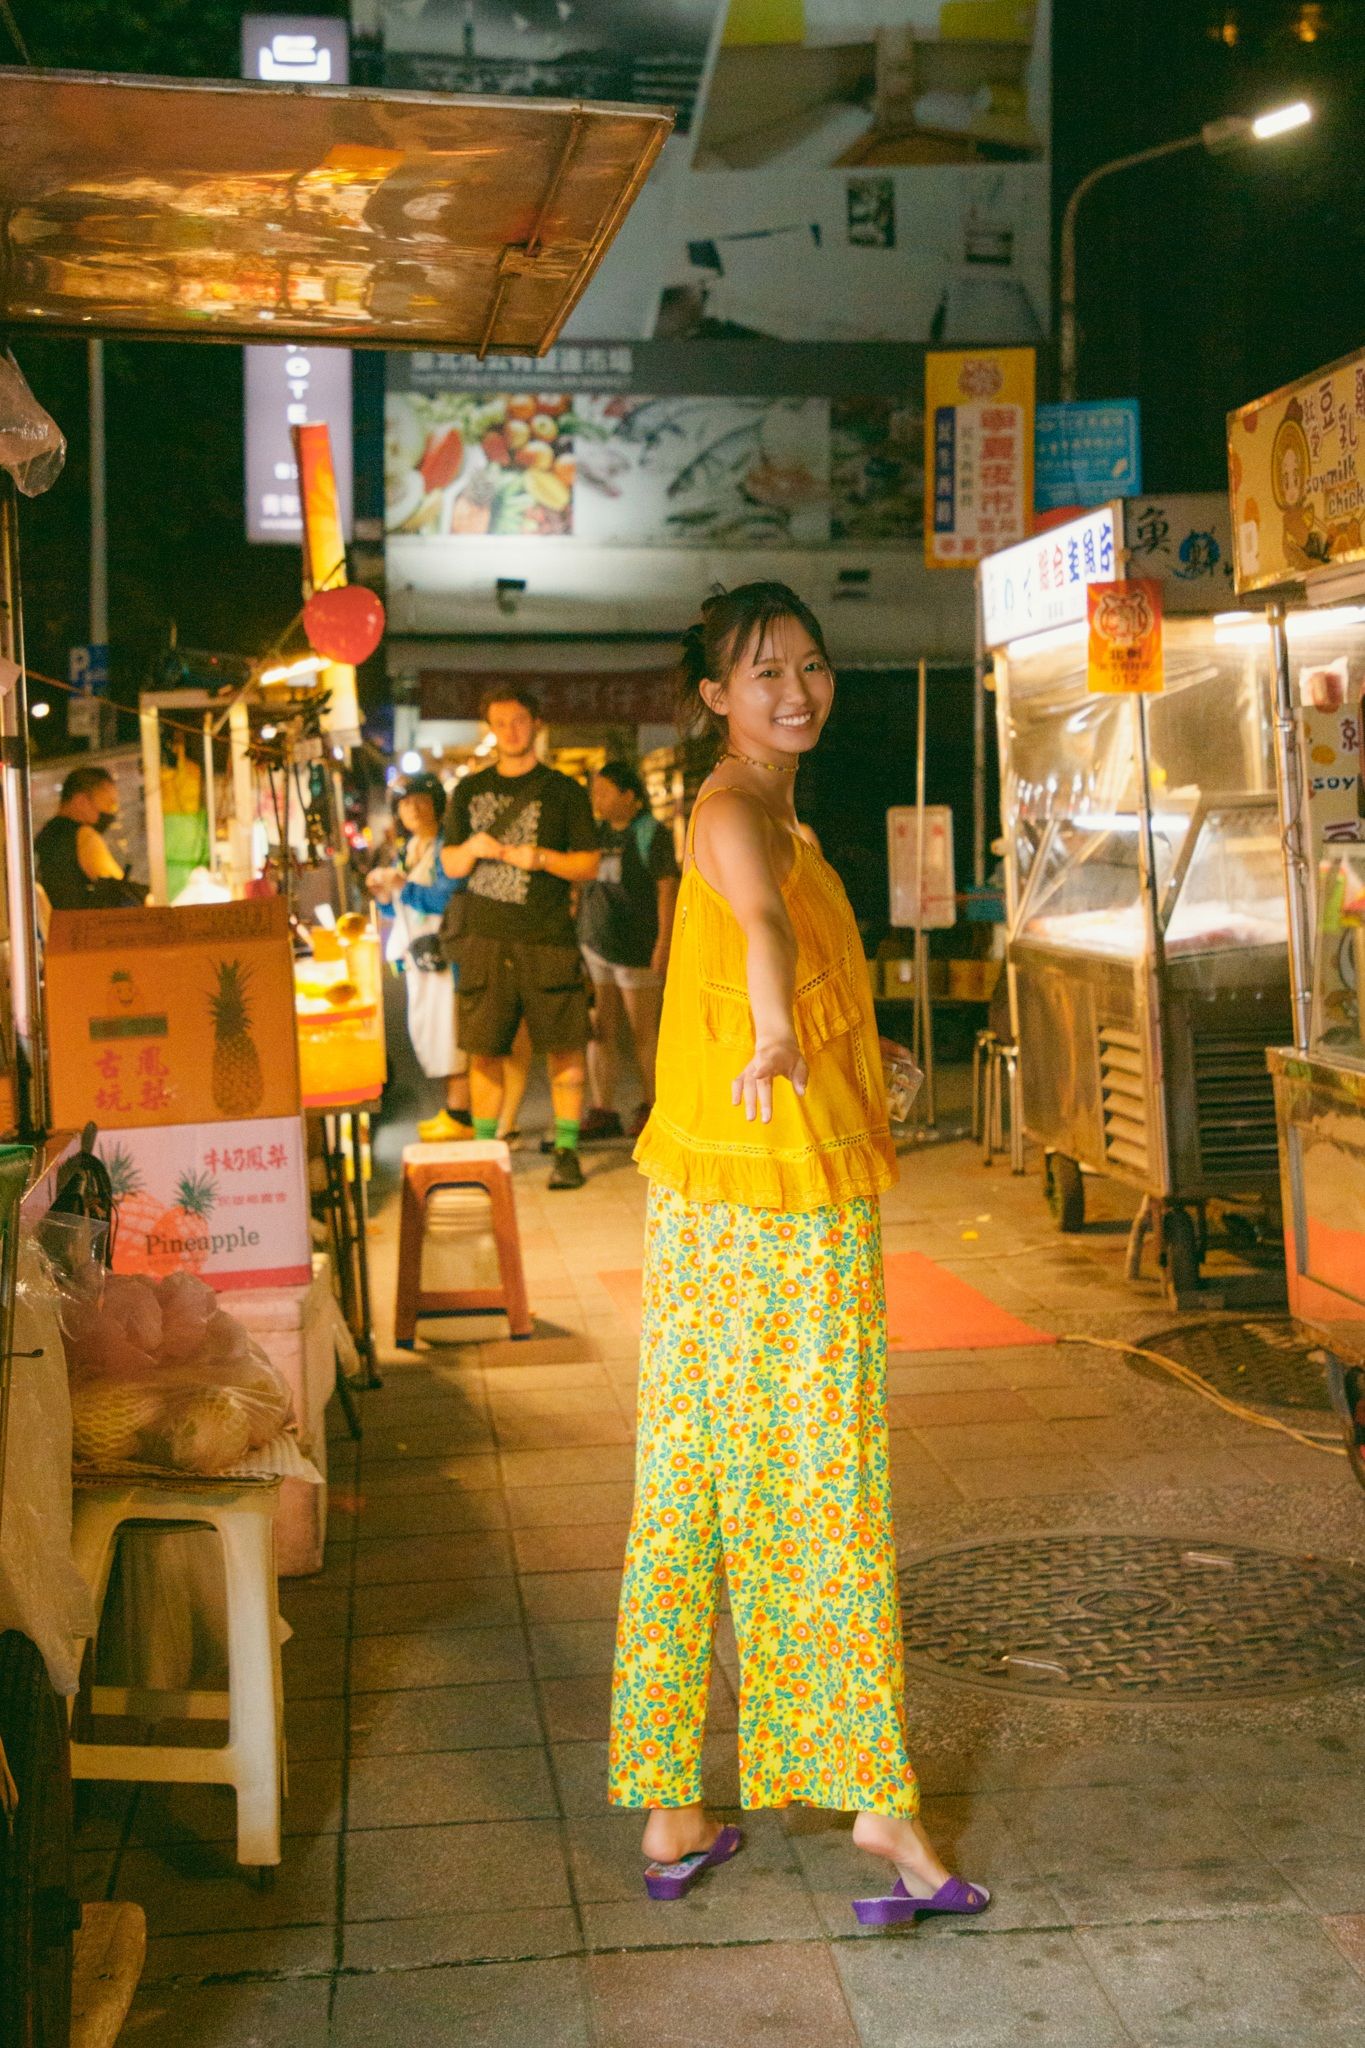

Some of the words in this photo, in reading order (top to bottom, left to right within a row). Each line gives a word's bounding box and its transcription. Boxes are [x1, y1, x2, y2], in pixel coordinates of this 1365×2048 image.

[1306, 454, 1356, 494] soymilk
[1111, 673, 1140, 685] 012
[203, 1143, 288, 1174] 牛奶鳳梨
[145, 1226, 261, 1257] Pineapple
